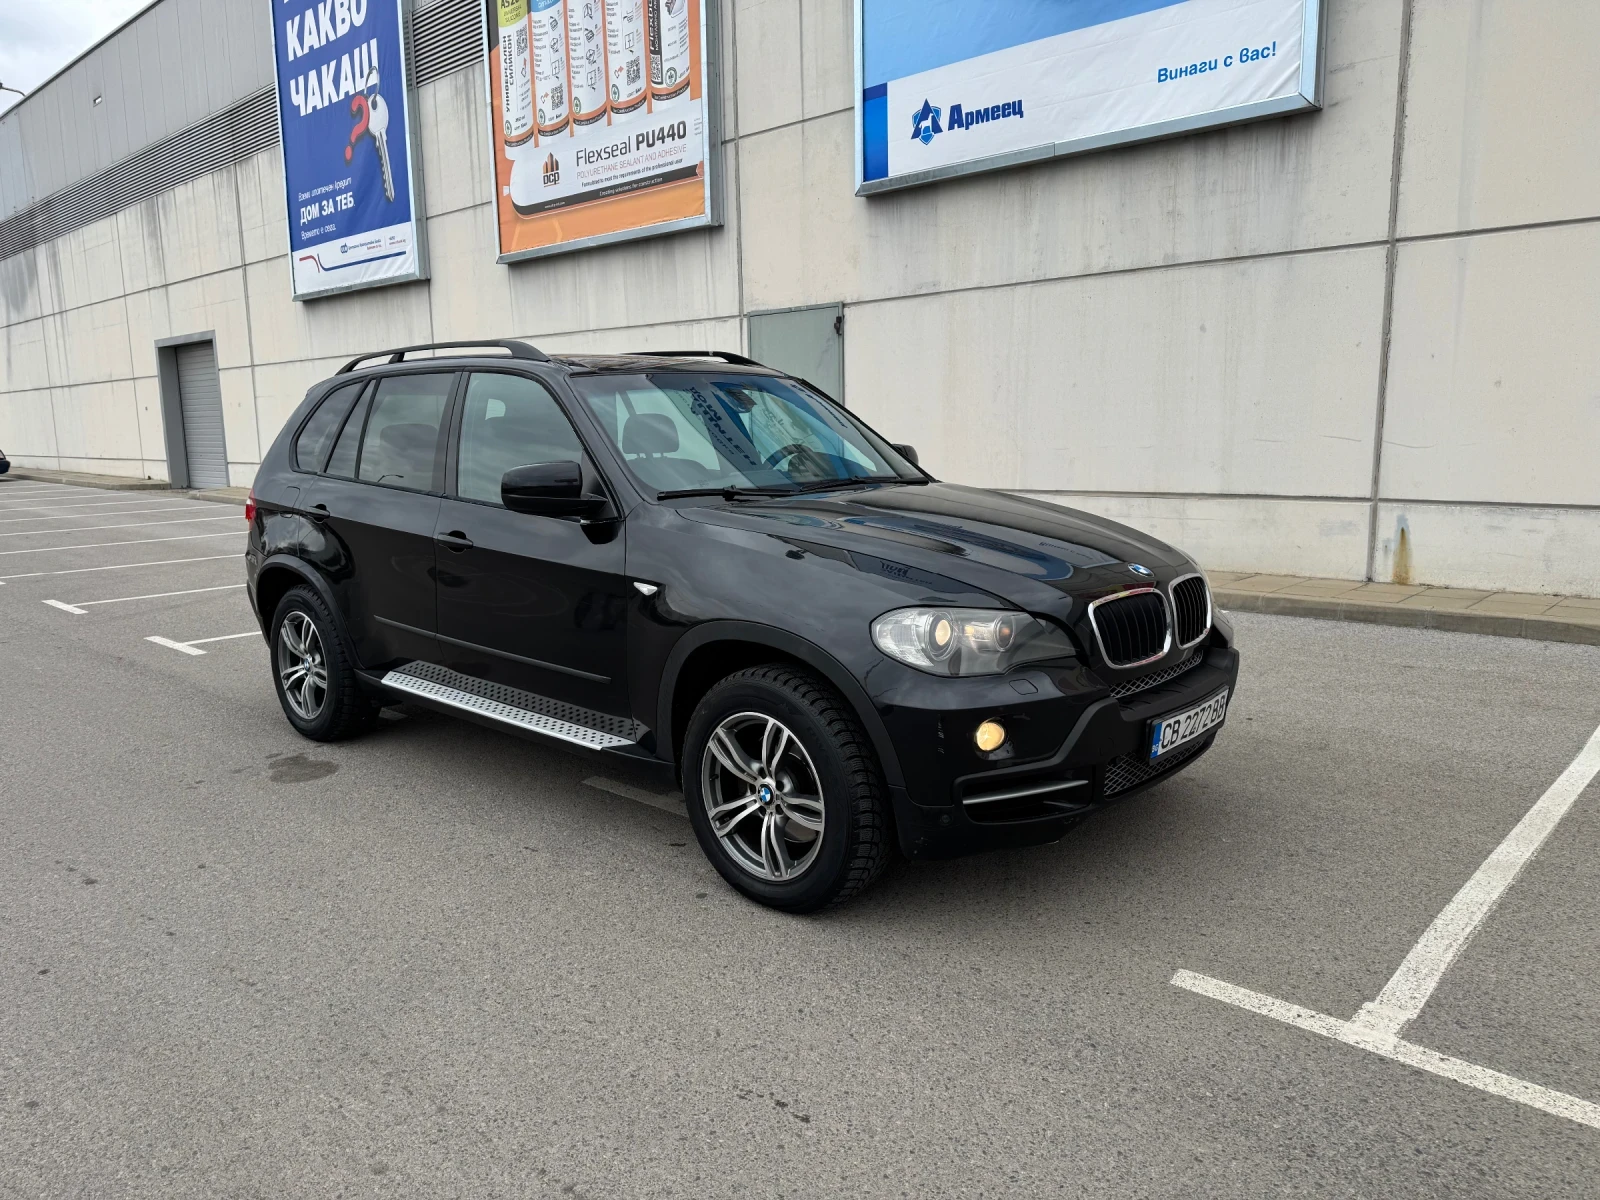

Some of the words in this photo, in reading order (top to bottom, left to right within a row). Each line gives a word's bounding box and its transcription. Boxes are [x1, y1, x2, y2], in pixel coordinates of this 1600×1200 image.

[286, 0, 367, 61] КАКВО
[1157, 58, 1218, 84] Винаги
[1223, 55, 1234, 68] с
[1239, 40, 1277, 64] вас!
[947, 99, 1024, 132] Армеец
[576, 135, 631, 167] Flexseal
[636, 120, 687, 151] PU440
[577, 162, 620, 180] POLYURETHANE
[619, 155, 644, 171] SEALANT
[644, 151, 657, 163] AND
[657, 143, 687, 159] ADHESIVE
[651, 160, 675, 172] professional
[599, 187, 615, 197] Creating
[638, 177, 663, 187] construction
[300, 202, 320, 227] ДОМ
[321, 198, 335, 216] ЗА
[335, 191, 356, 212] ТЕБ.
[1161, 719, 1181, 749] CB
[1180, 703, 1212, 741] 2272
